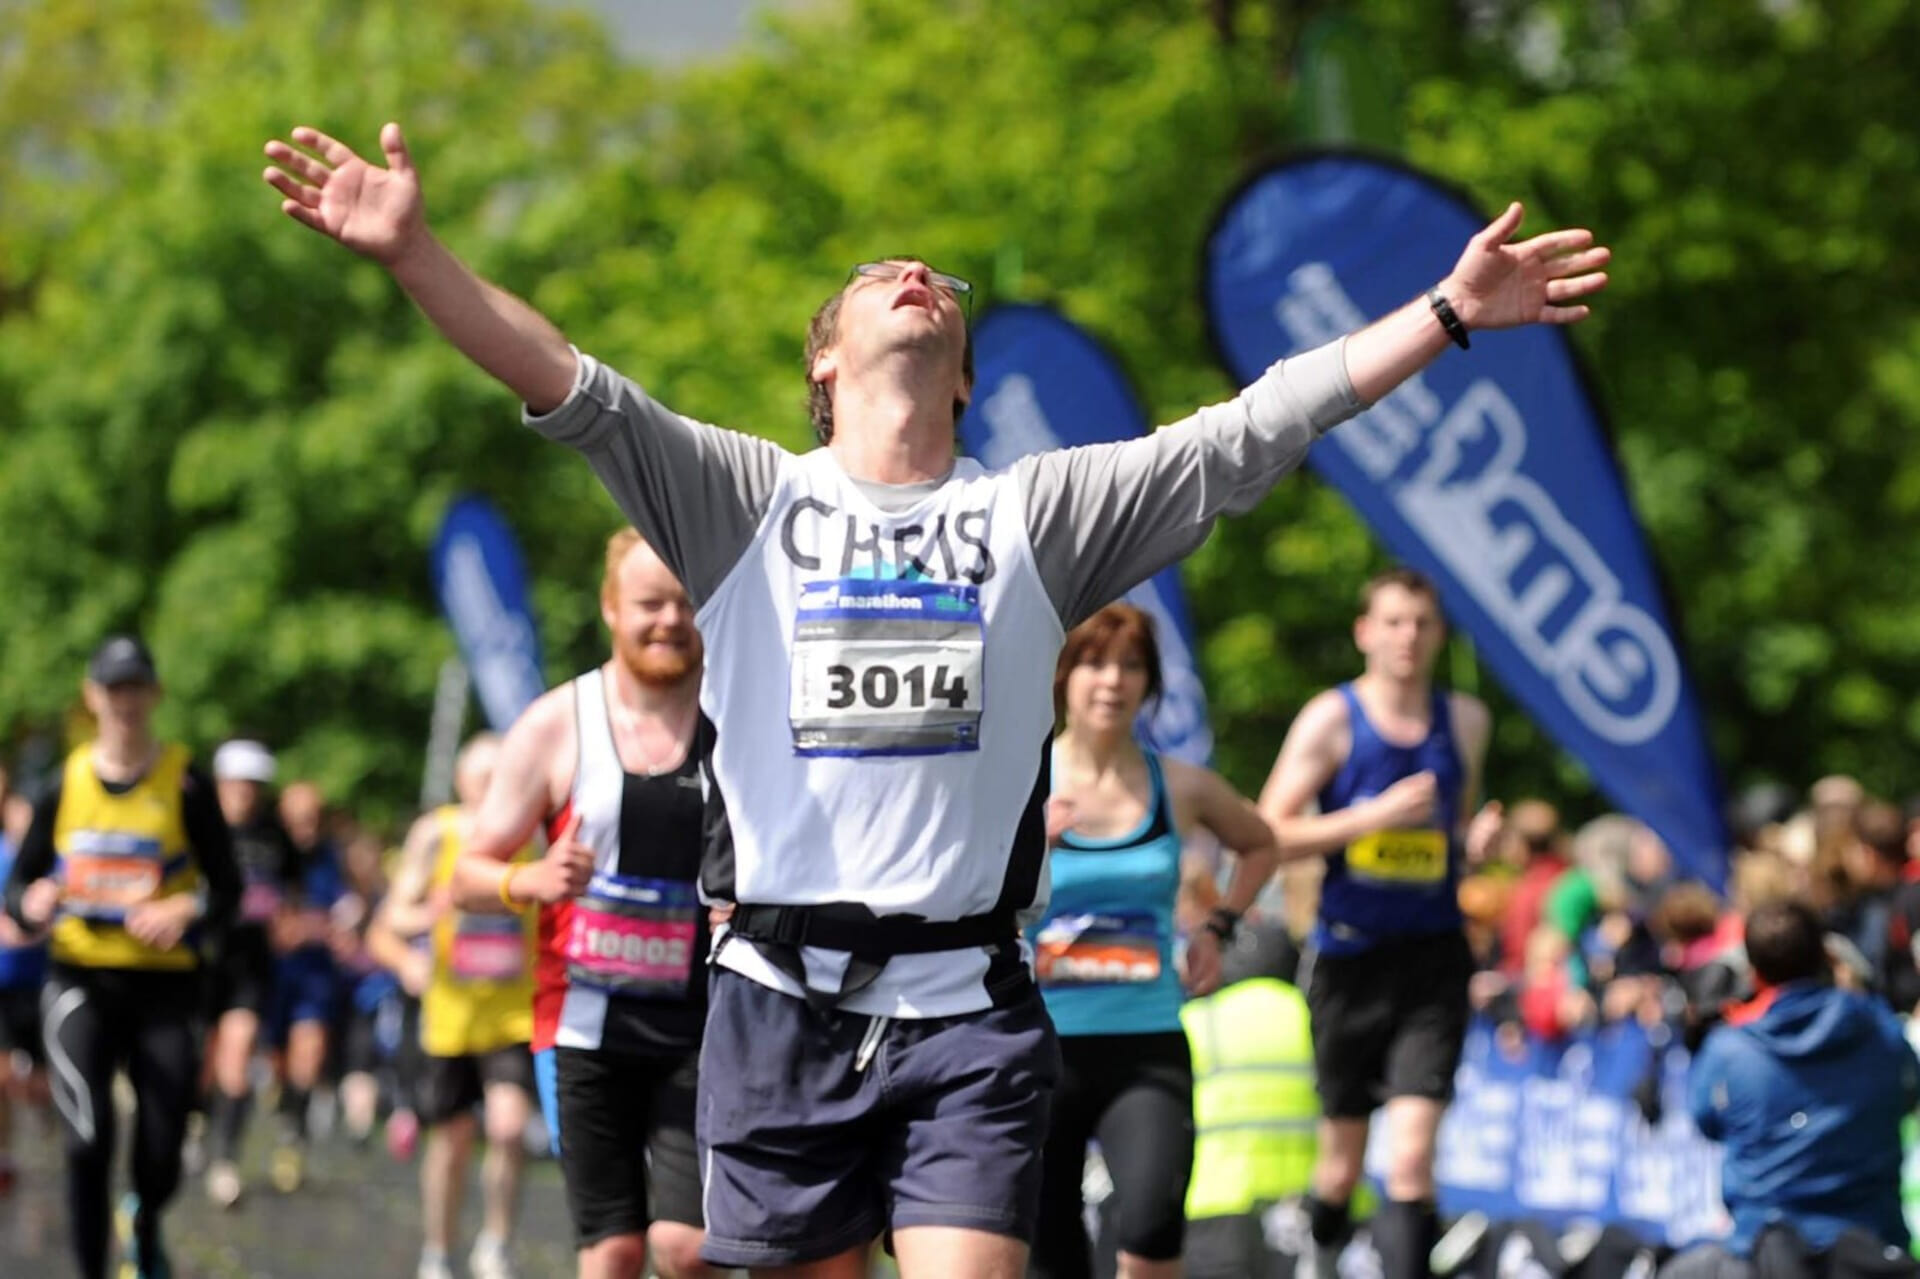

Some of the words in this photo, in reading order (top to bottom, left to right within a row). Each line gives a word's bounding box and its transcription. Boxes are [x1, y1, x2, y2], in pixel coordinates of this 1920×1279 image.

[780, 496, 997, 585] CHRIS
[838, 593, 923, 610] marathon
[826, 664, 969, 709] 3014
